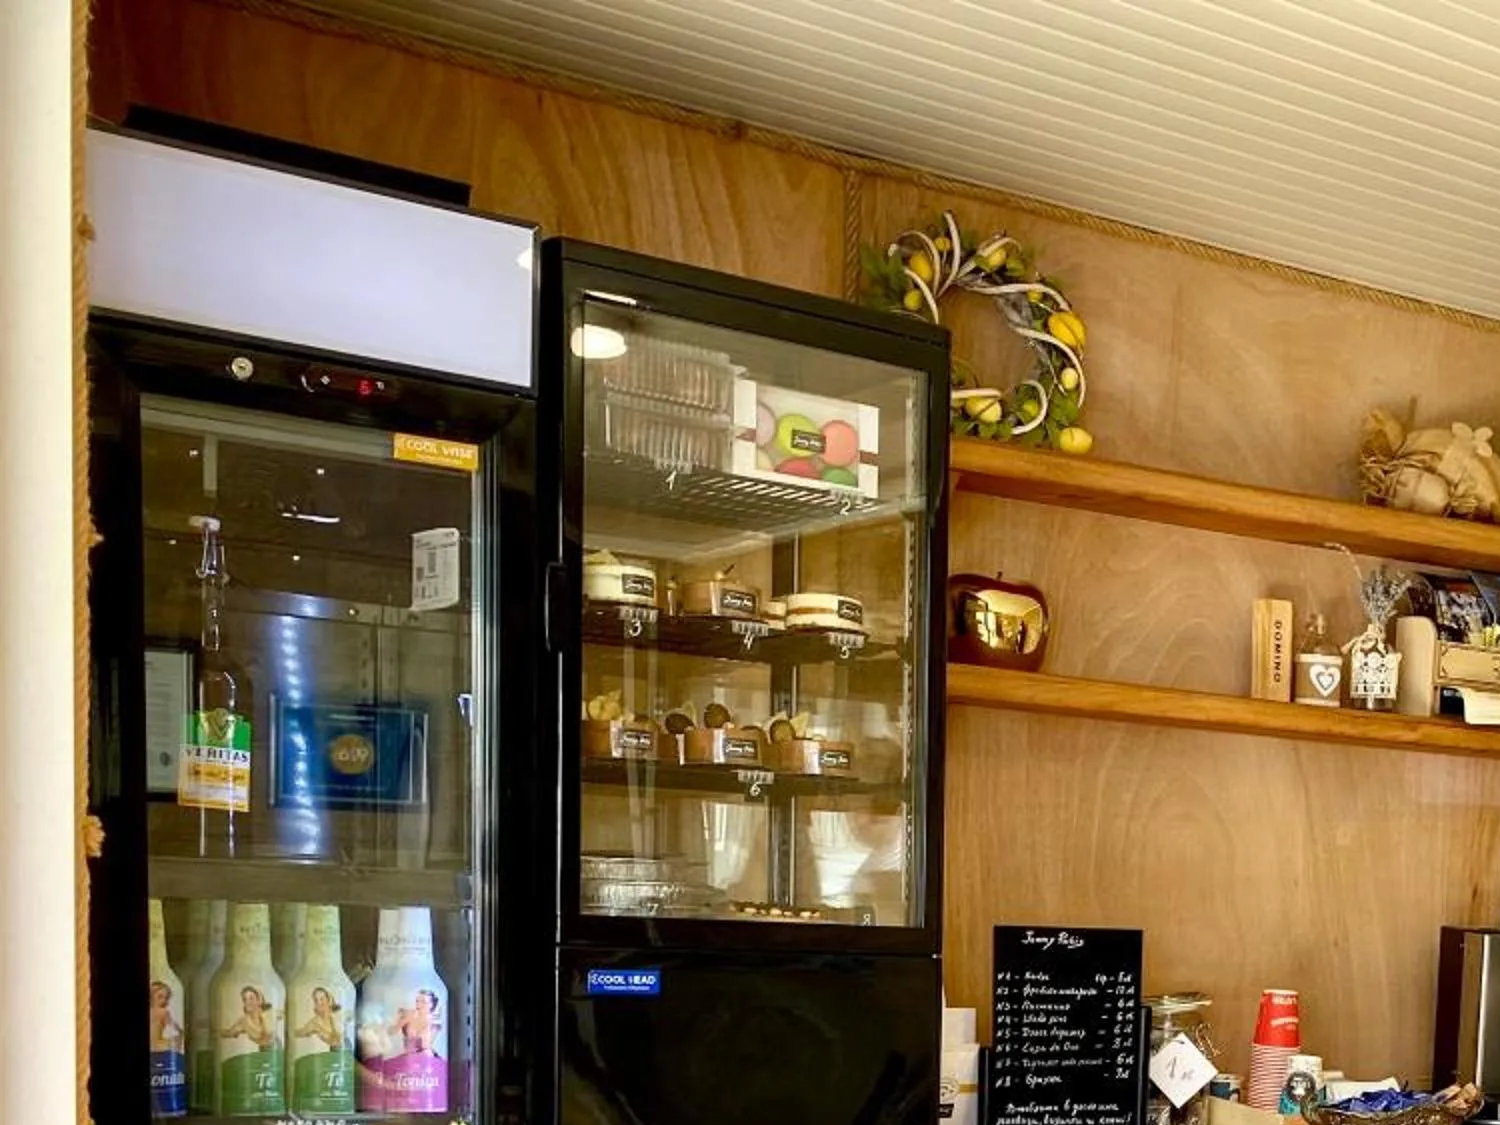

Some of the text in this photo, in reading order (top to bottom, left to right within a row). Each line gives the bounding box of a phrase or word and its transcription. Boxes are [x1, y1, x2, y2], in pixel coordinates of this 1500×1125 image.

[840, 501, 852, 516] 2
[630, 620, 643, 637] 3
[1273, 620, 1283, 682] DOMINO
[750, 781, 761, 797] 6
